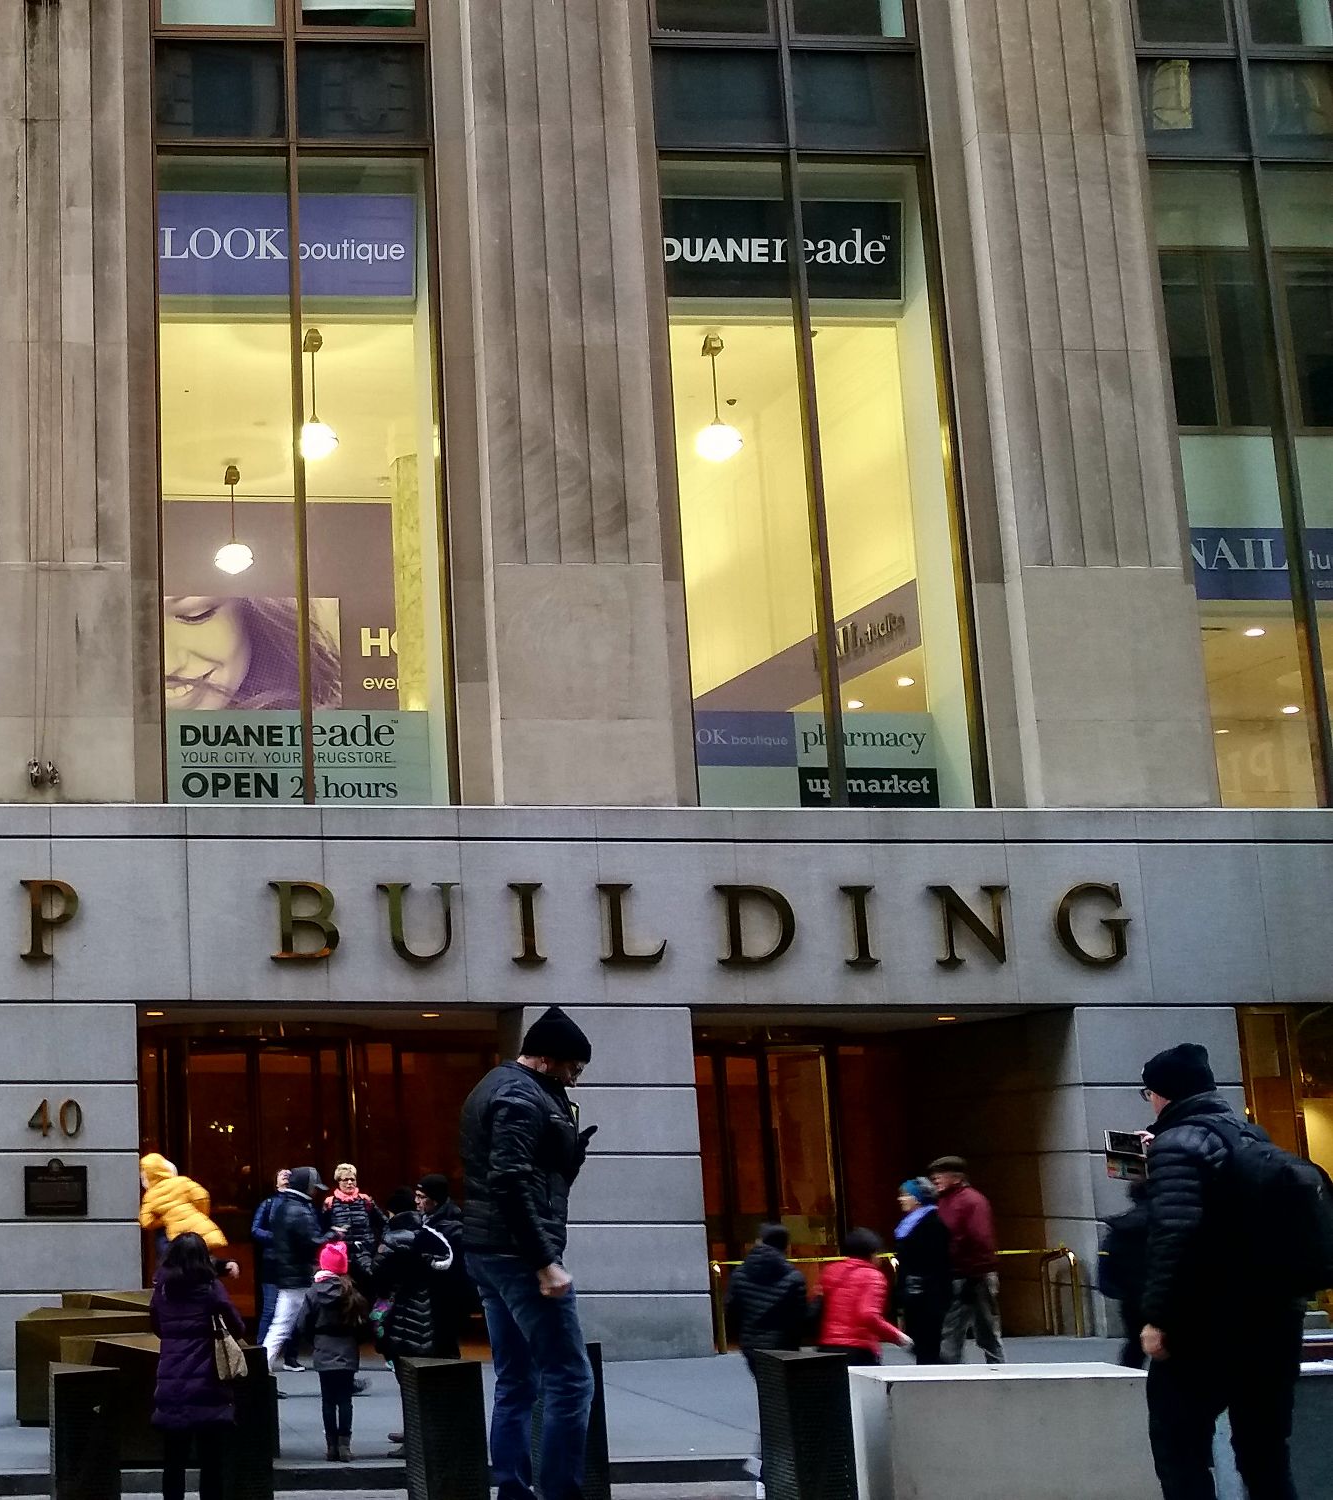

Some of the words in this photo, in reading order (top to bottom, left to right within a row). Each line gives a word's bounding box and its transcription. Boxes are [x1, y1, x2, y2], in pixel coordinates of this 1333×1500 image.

[160, 227, 288, 261] LOOK
[663, 237, 769, 263] DUANE
[1190, 537, 1289, 571] NAIL
[180, 725, 283, 747] DUANE
[731, 735, 788, 747] boutique
[181, 752, 218, 764] YOUR
[264, 752, 302, 764] YOUR
[314, 752, 396, 764] RUGSTORE.
[182, 772, 278, 798] OPEN
[322, 775, 398, 799] hours
[847, 775, 931, 794] market
[267, 880, 1131, 966] BUILDING
[28, 1099, 83, 1137] 40
